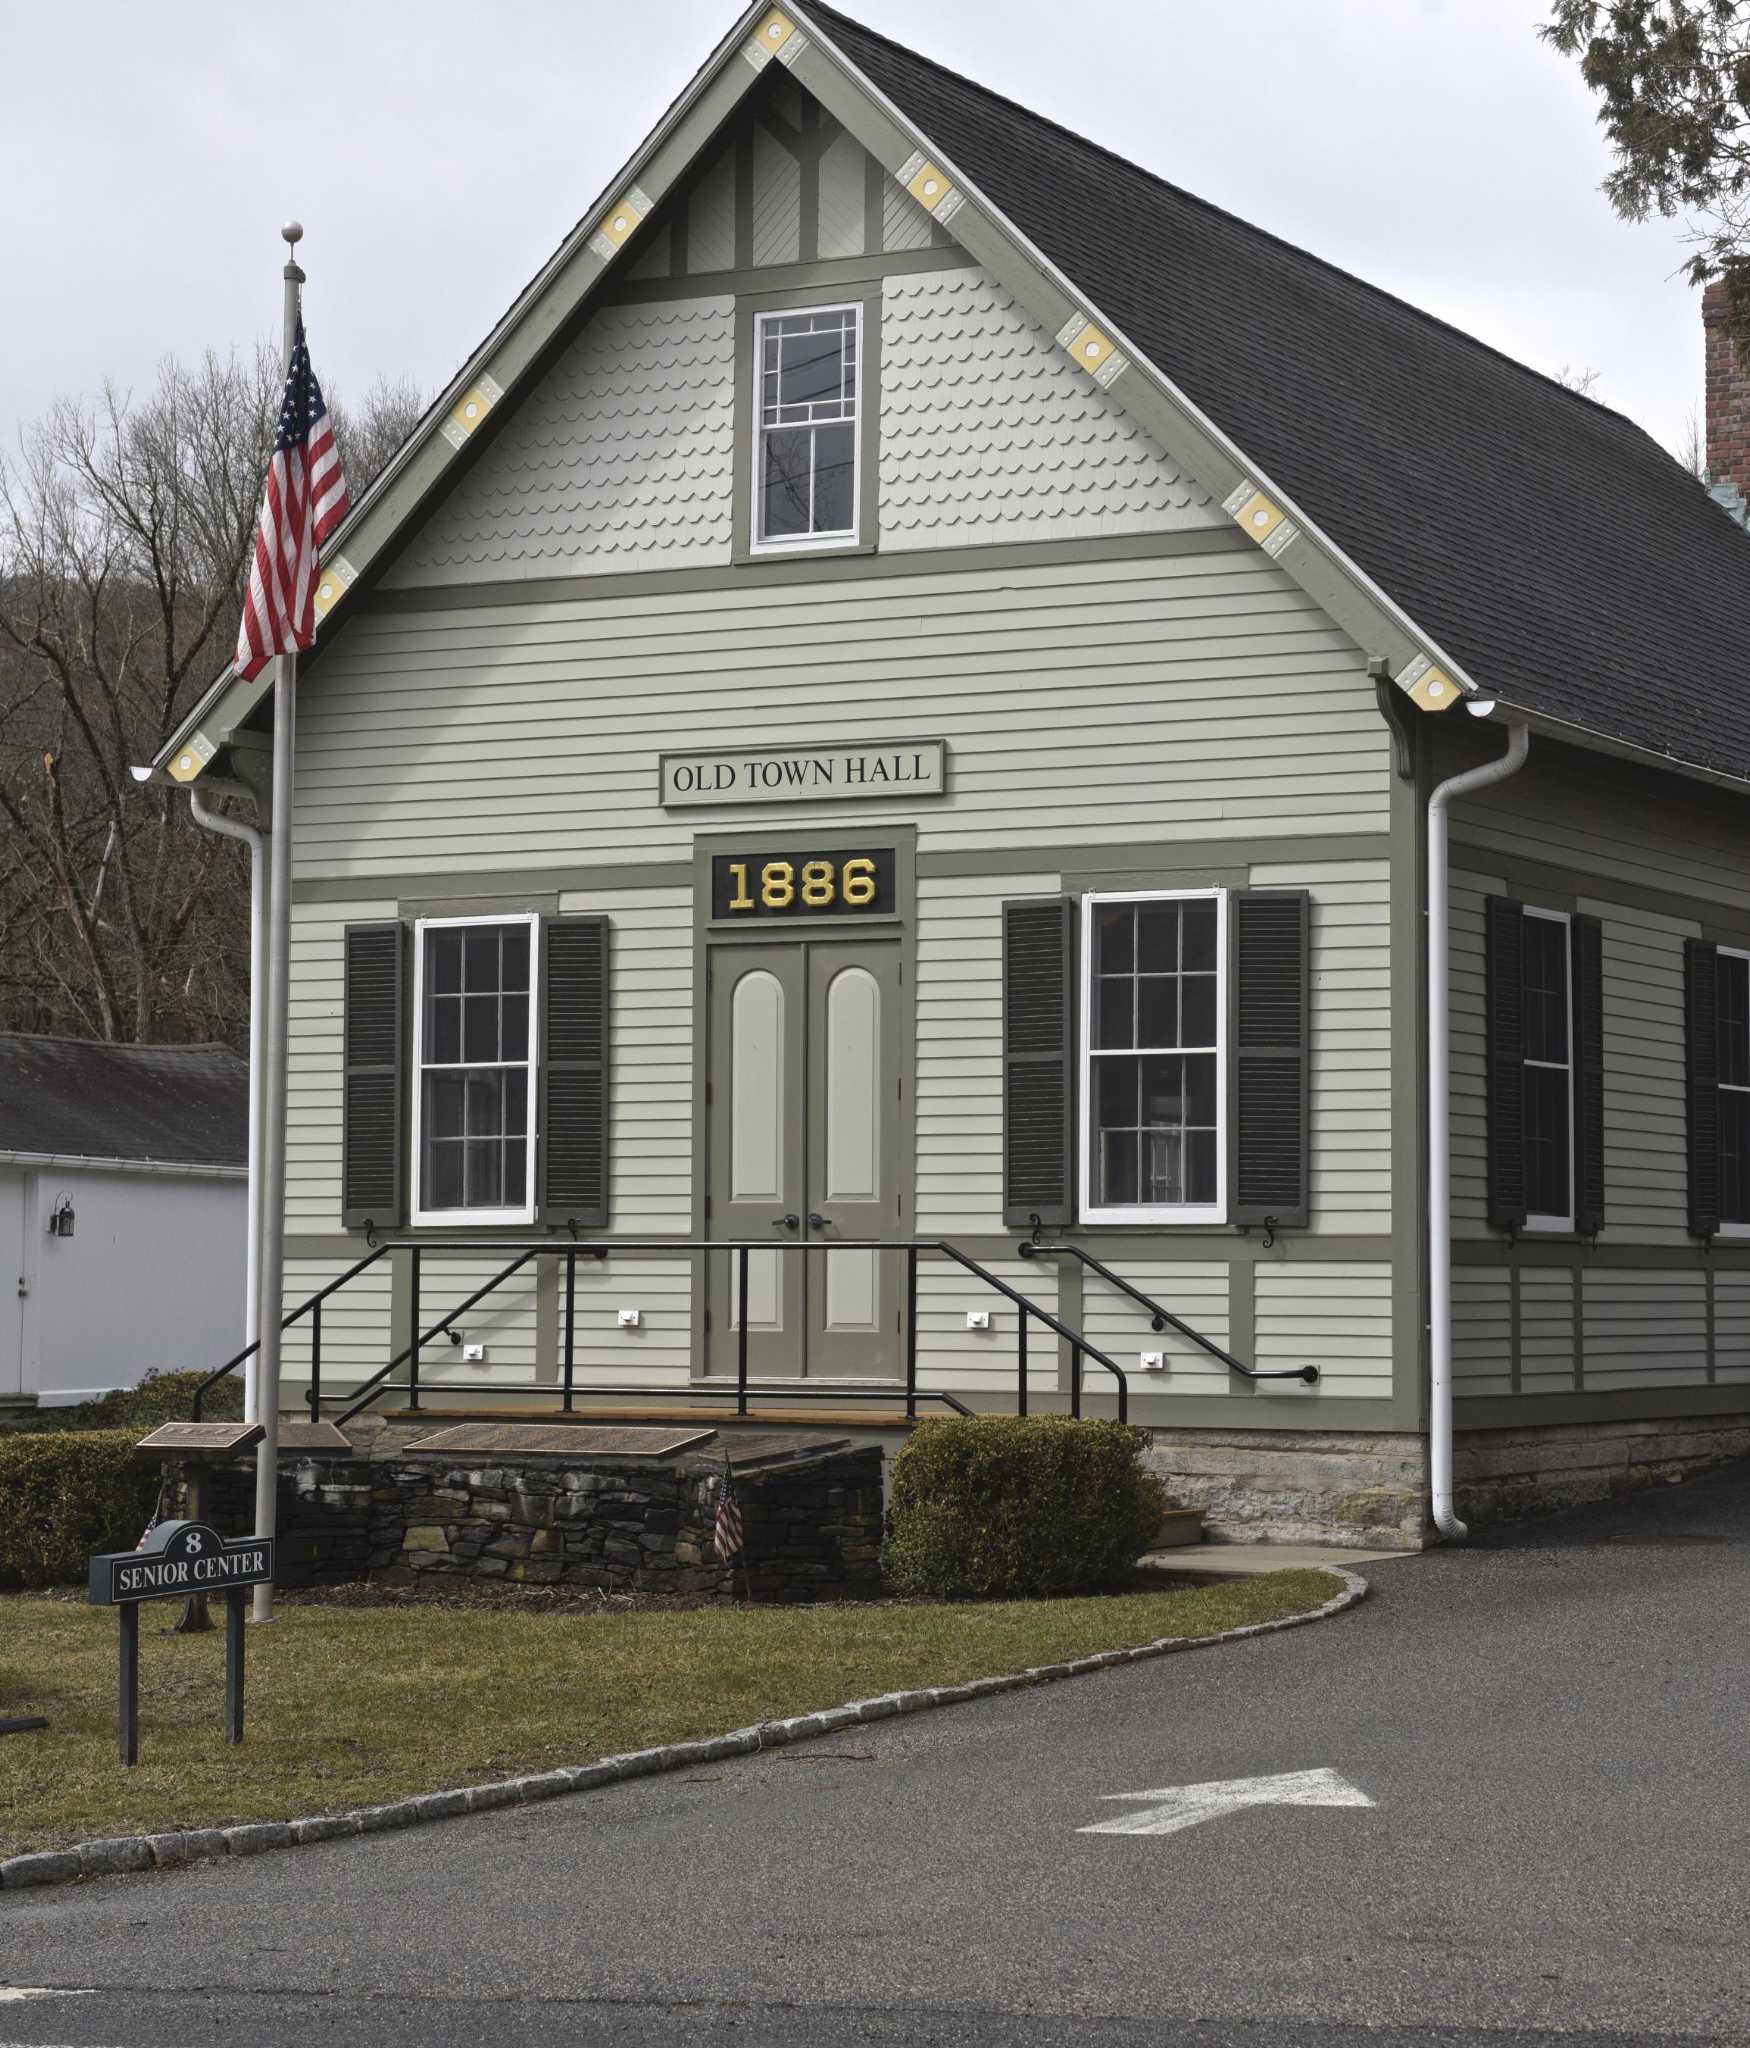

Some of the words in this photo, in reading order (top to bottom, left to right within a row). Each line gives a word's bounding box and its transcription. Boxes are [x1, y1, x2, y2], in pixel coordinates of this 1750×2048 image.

[673, 764, 736, 792] OLD
[744, 758, 835, 788] TOWN
[843, 754, 931, 784] HALL
[729, 858, 879, 910] 1886
[185, 1532, 202, 1554] 8
[119, 1562, 189, 1591] SENIOR
[193, 1551, 264, 1580] CENTER
